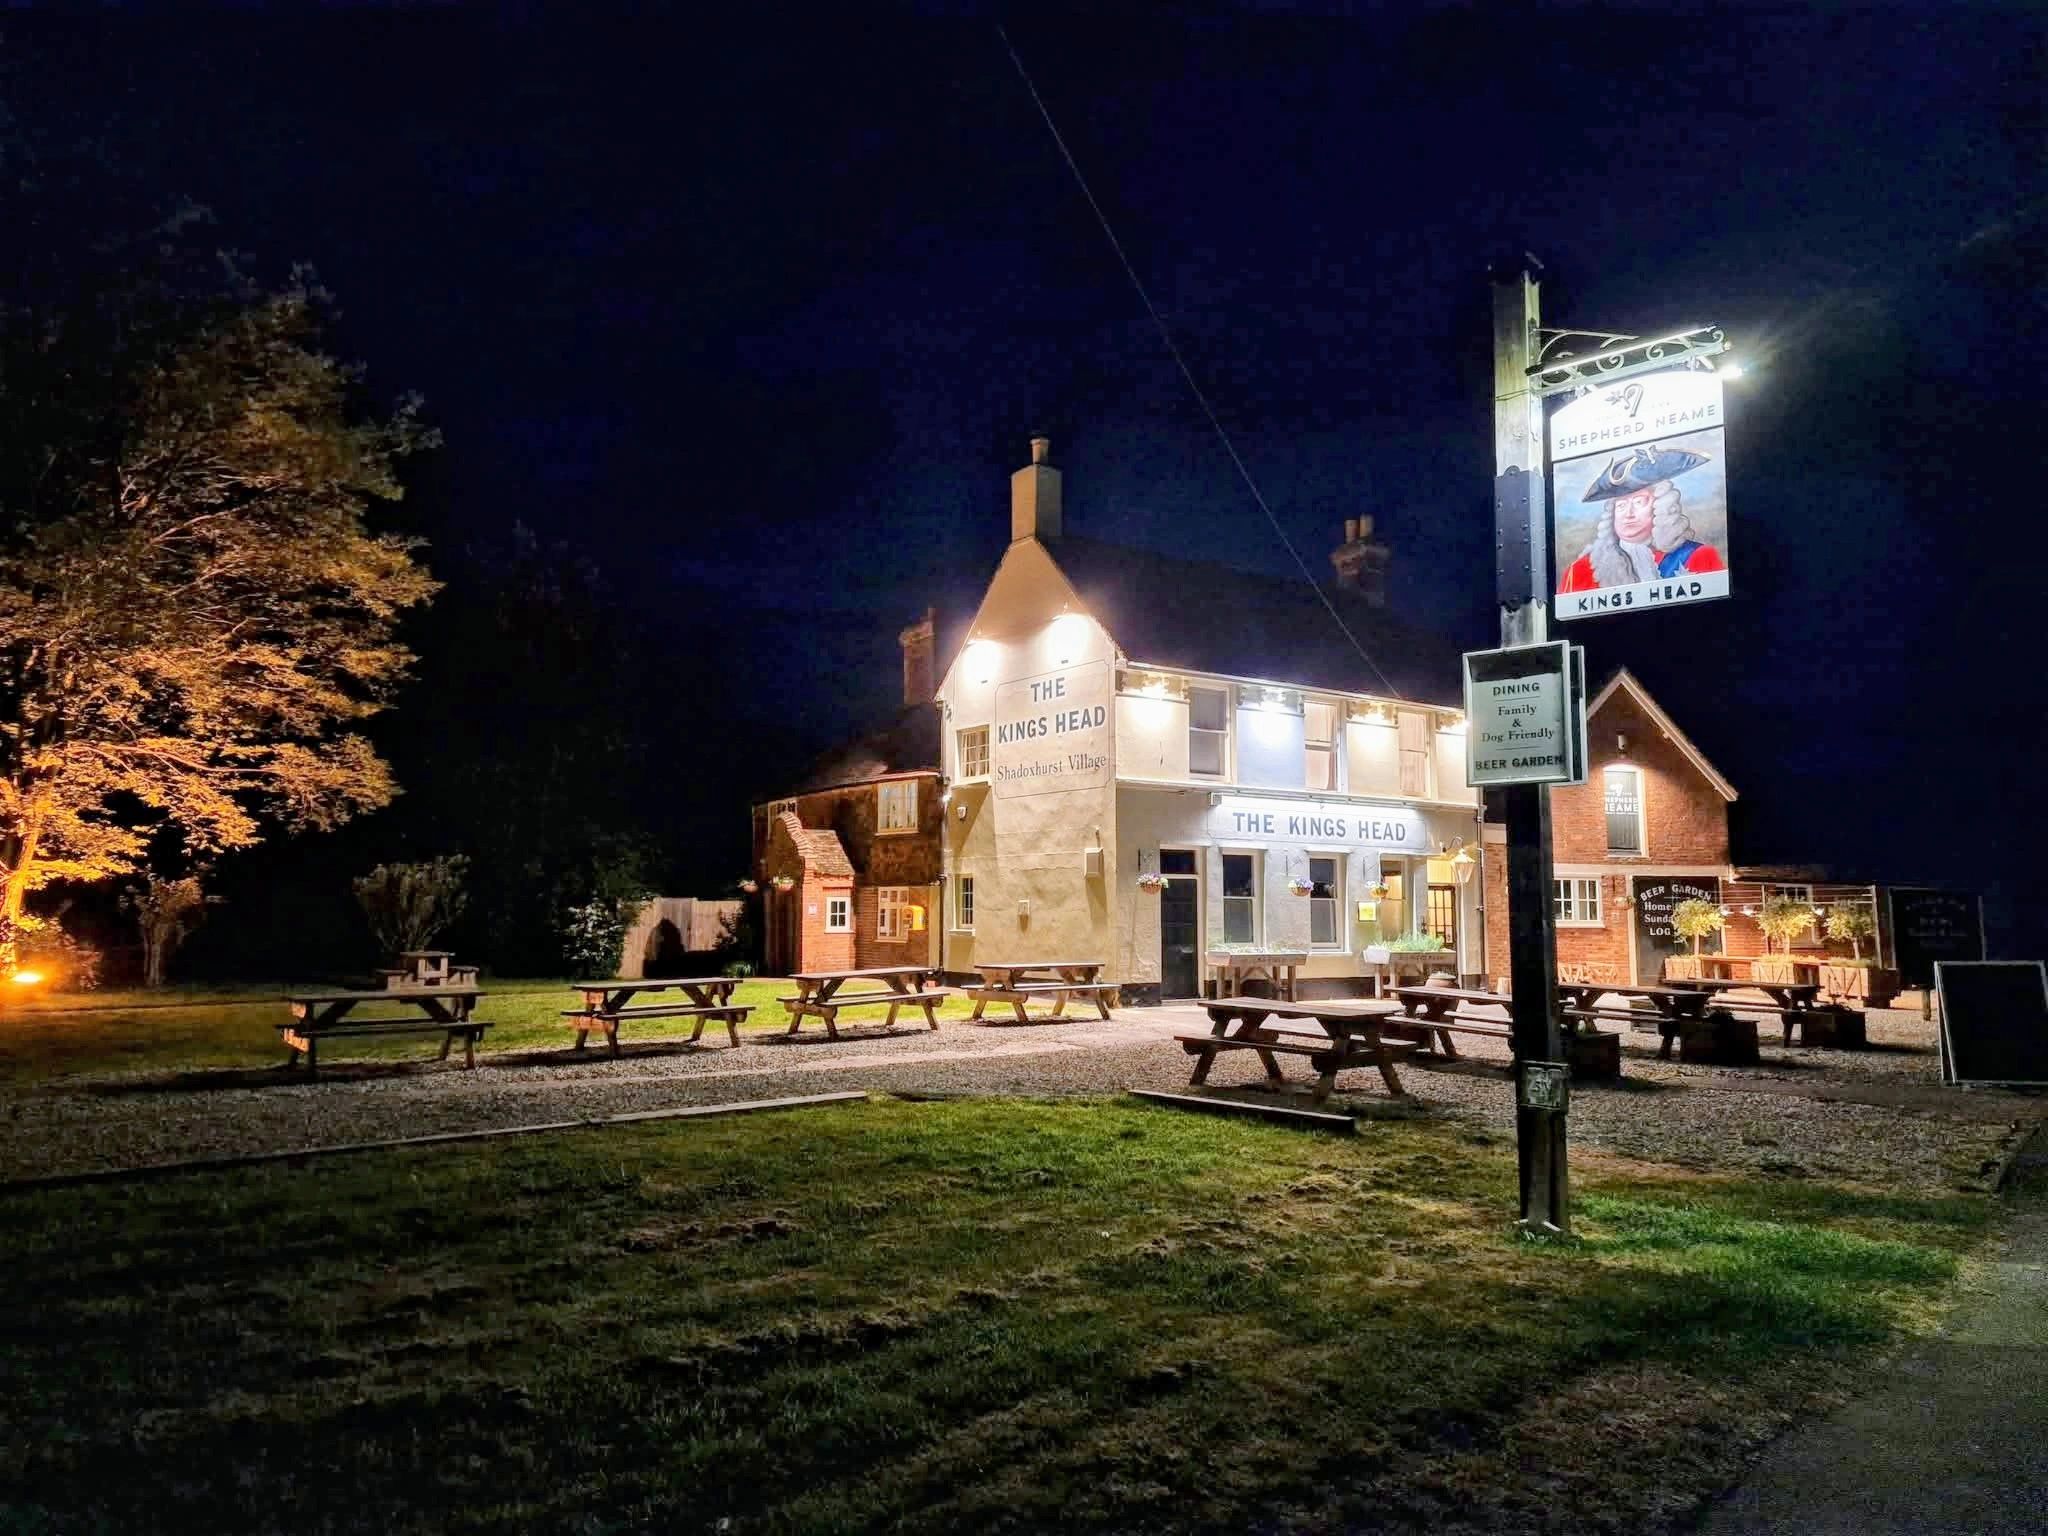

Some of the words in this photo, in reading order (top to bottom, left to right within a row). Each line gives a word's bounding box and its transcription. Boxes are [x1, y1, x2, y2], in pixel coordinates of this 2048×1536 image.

[1559, 422, 1645, 449] SHEPHERD
[1656, 404, 1715, 428] NEAME
[1578, 591, 1633, 612] KINGS
[1650, 582, 1701, 601] HEAD
[1031, 677, 1065, 702] THE
[1493, 682, 1540, 697] DINING
[1498, 704, 1537, 716] Family
[998, 717, 1047, 744] KINGS
[1055, 706, 1106, 733] HEAD
[1512, 718, 1522, 728] &
[1482, 732, 1504, 743] Dog
[1508, 728, 1554, 741] Friendly
[997, 761, 1062, 781] Shadoxhurst
[1068, 753, 1107, 771] Village
[1475, 759, 1507, 770] BEER
[1512, 755, 1563, 768] GARDEN
[1232, 812, 1275, 834] THE
[1289, 815, 1346, 837] KINGS
[1358, 820, 1406, 841] HEAD
[1640, 886, 1665, 901] BEER
[1671, 884, 1712, 901] GARDEN
[1644, 901, 1672, 911] Home
[1644, 914, 1674, 923] Sunda
[1650, 927, 1671, 936] LOG
